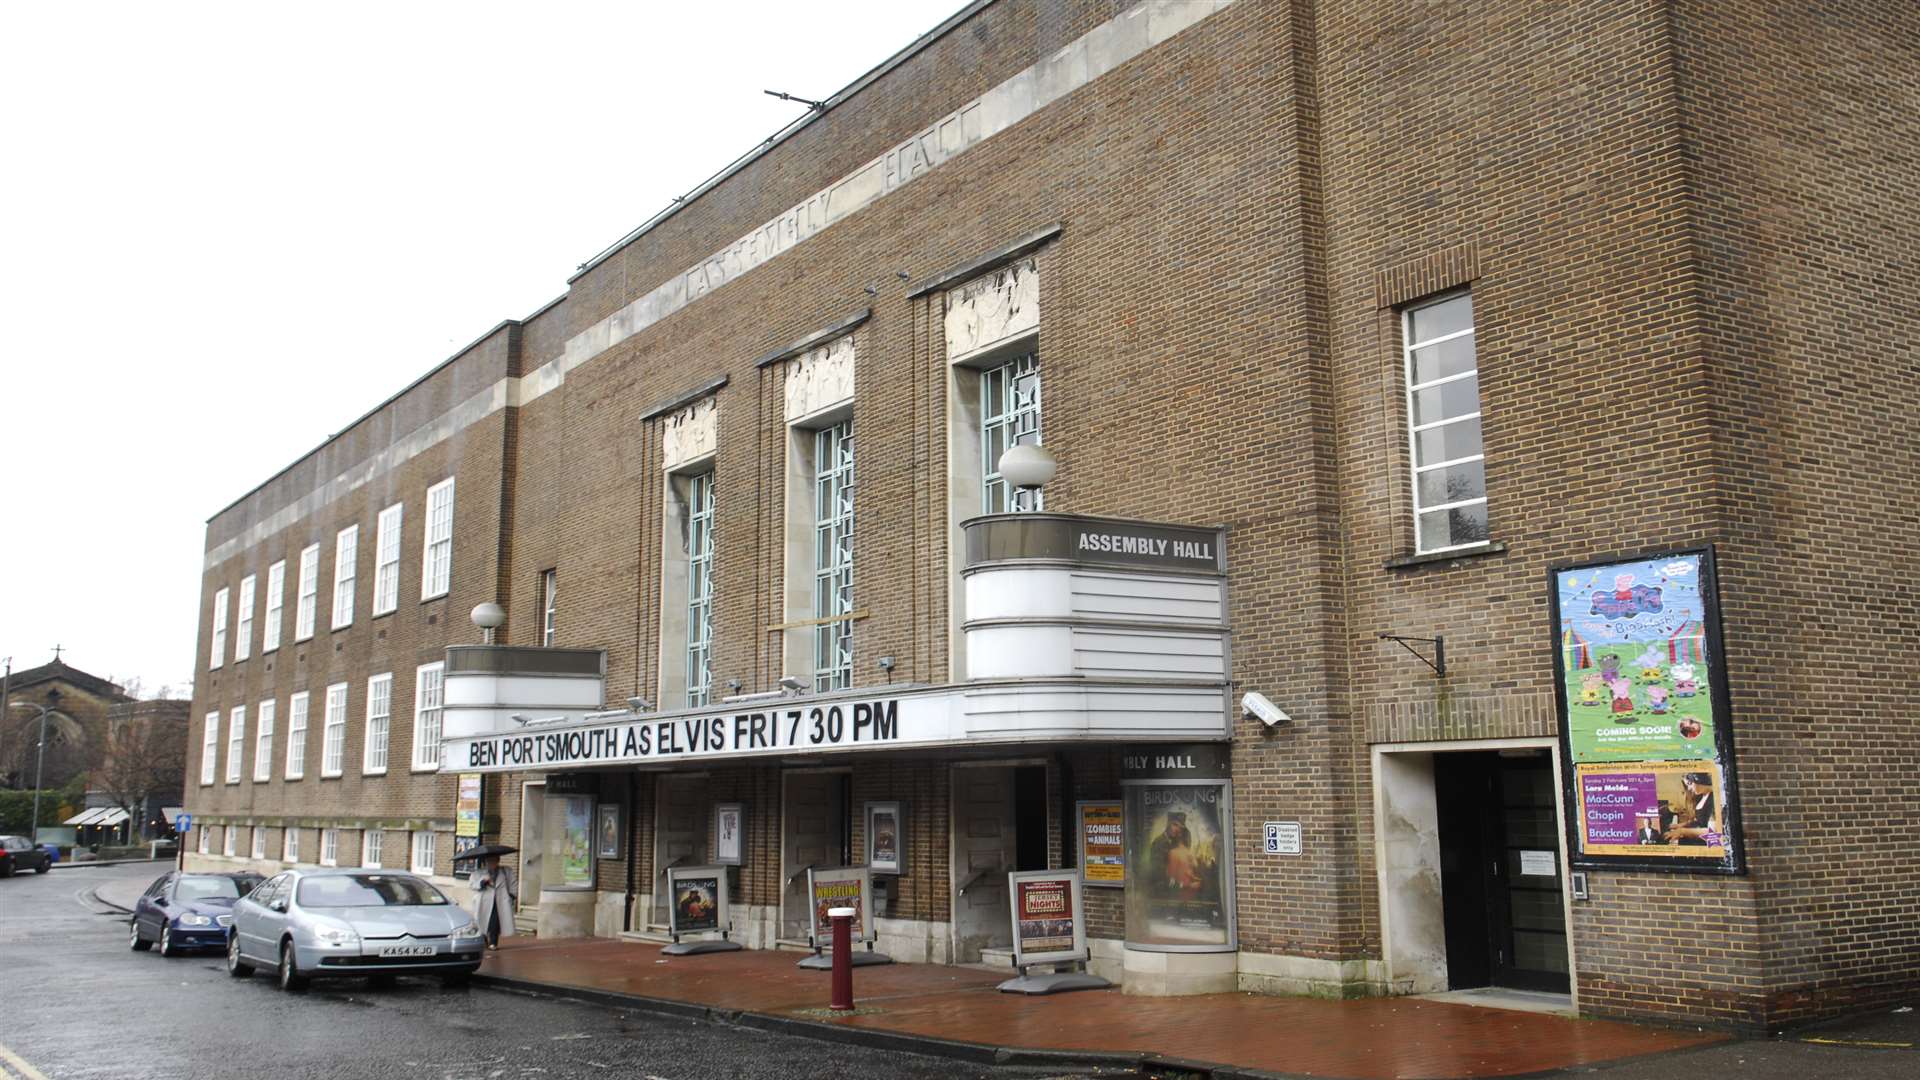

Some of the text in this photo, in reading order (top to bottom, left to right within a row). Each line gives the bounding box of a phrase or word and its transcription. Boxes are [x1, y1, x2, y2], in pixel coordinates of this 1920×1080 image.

[689, 104, 980, 301] ASSEMBLY HALL
[1079, 532, 1214, 560] ASSEMBLY HALL
[470, 700, 899, 767] BEN PORTSMOUTH AS ELVIS FRI 7 30 PM
[1596, 726, 1672, 737] COMING SOON!
[1156, 755, 1196, 769] HALL
[1586, 794, 1634, 804] MacCunn
[1588, 810, 1624, 822] Chopin
[1087, 824, 1122, 834] ZOMBIES
[1589, 828, 1633, 838] Bruckner
[1093, 836, 1121, 845] ANIMALS
[815, 885, 860, 898] WRESTLING
[1030, 899, 1061, 908] NIGHTS
[383, 946, 410, 955] KA54
